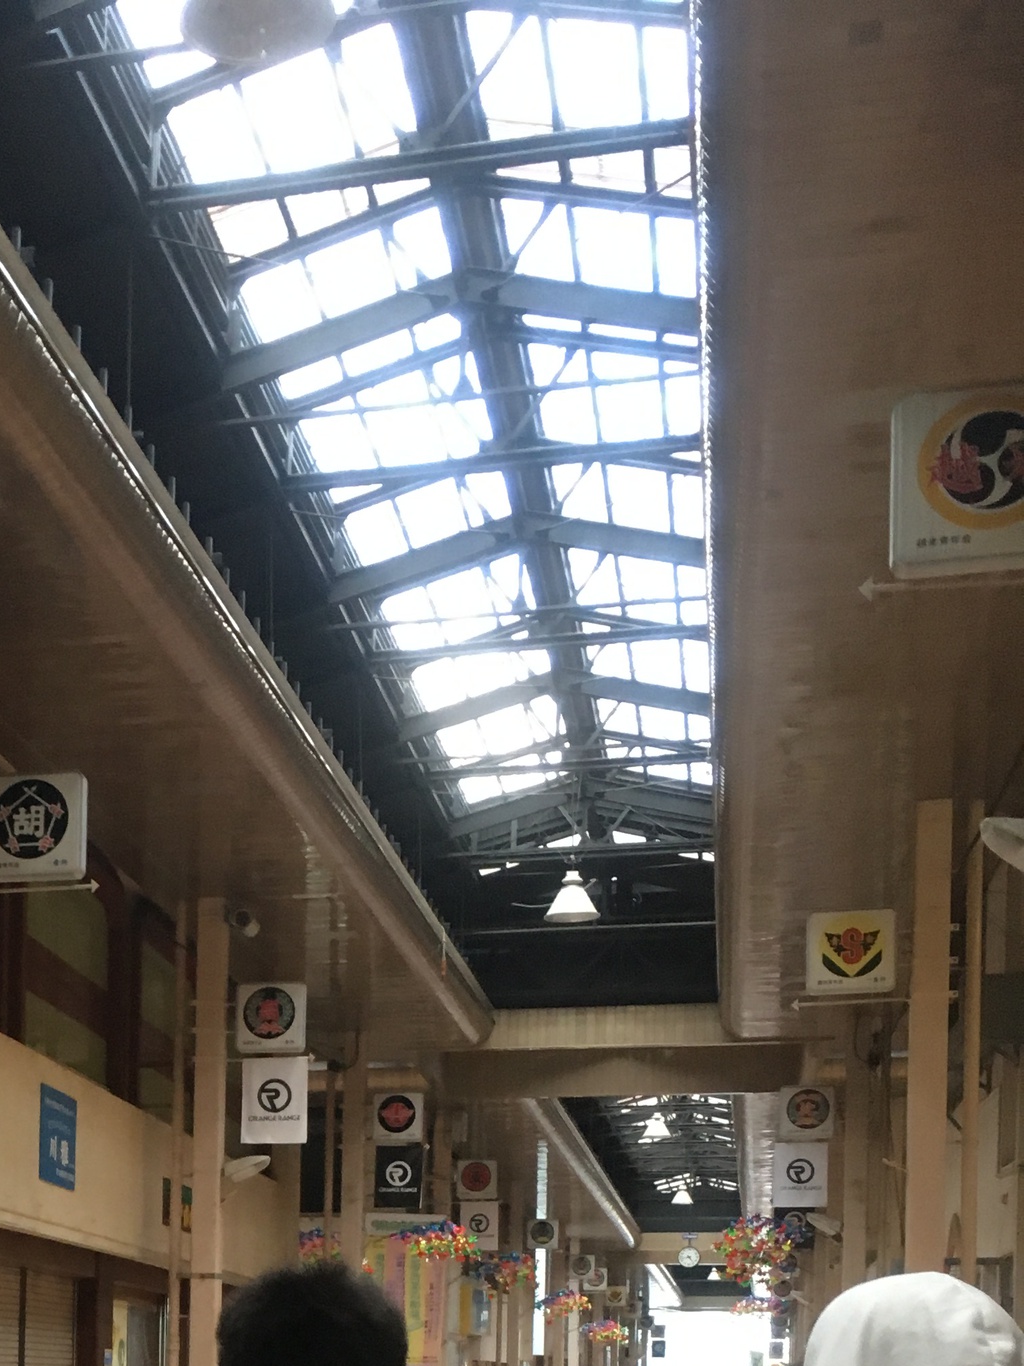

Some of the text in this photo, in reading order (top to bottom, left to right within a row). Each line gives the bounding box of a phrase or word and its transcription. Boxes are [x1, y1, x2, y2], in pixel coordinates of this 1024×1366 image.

[13, 805, 46, 838] 胡
[248, 1114, 301, 1122] ORANGE RANGE
